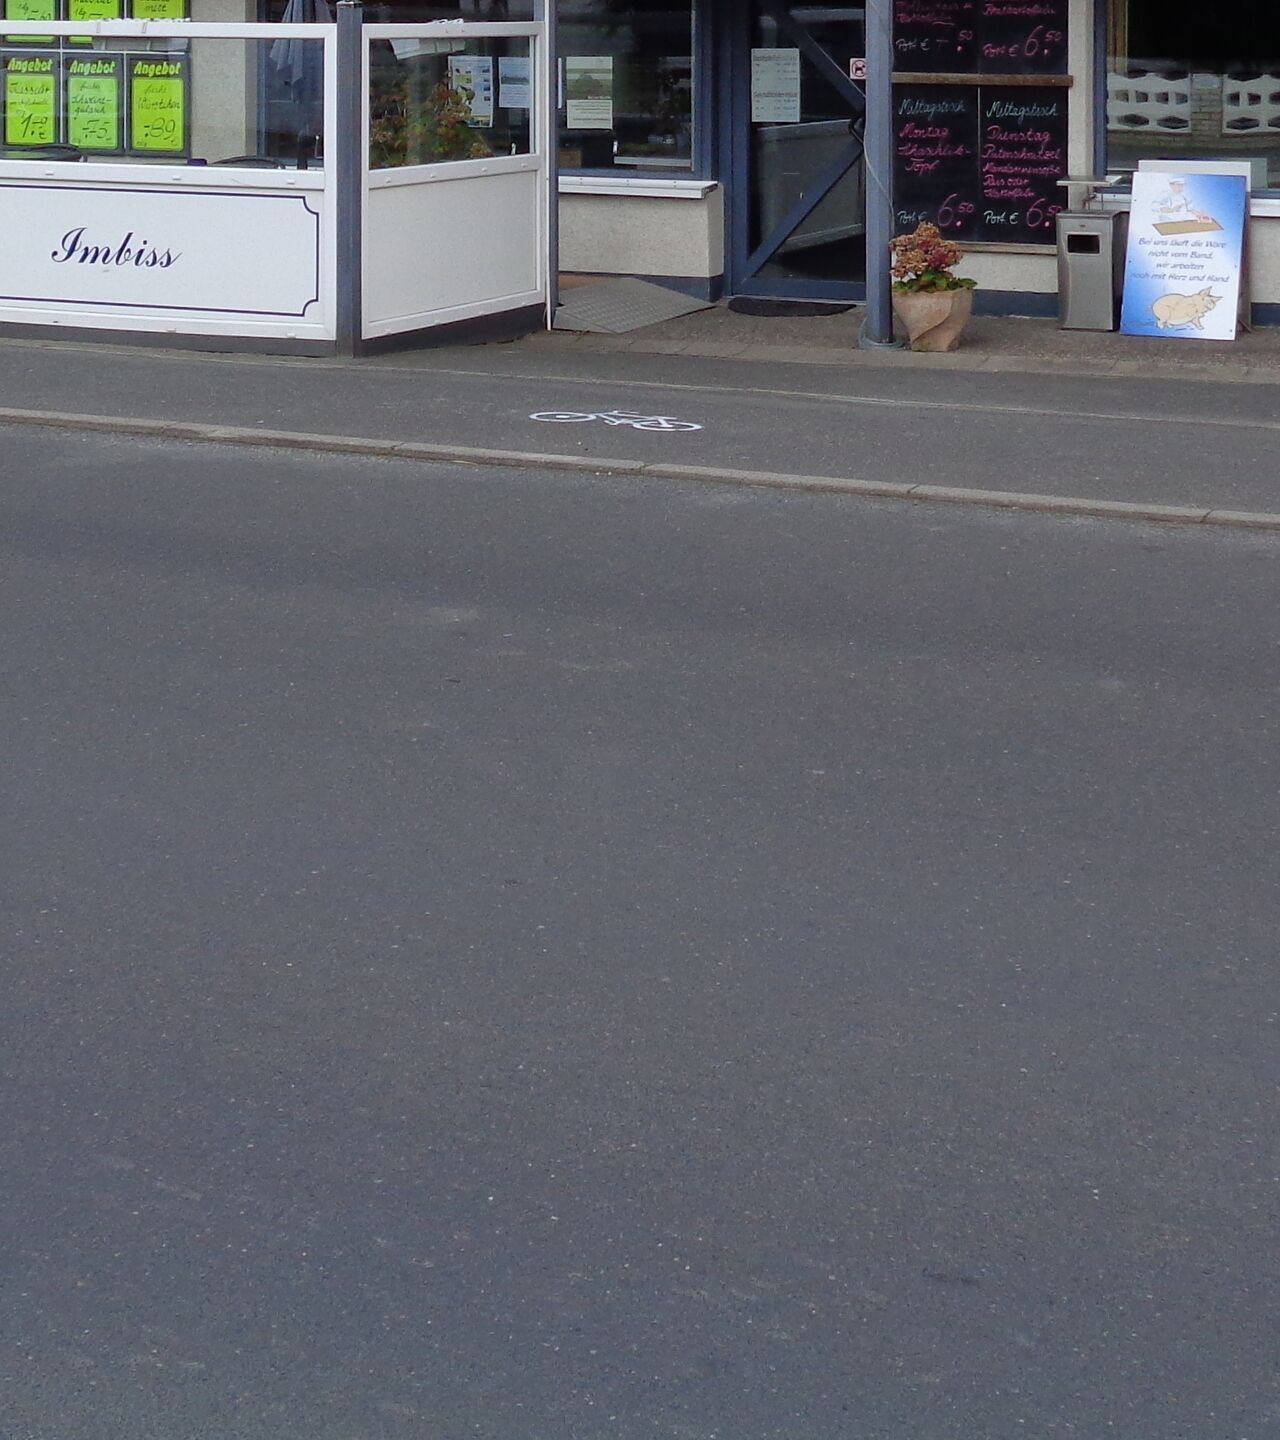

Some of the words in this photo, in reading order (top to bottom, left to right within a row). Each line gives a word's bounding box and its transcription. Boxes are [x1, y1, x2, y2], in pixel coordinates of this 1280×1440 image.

[7, 57, 54, 74] Angebot
[69, 59, 117, 76] Angebot
[133, 61, 182, 77] Angebot
[986, 101, 1059, 125] Mittagstisch
[986, 125, 1051, 148] Dienstag
[51, 227, 183, 268] Imbiss
